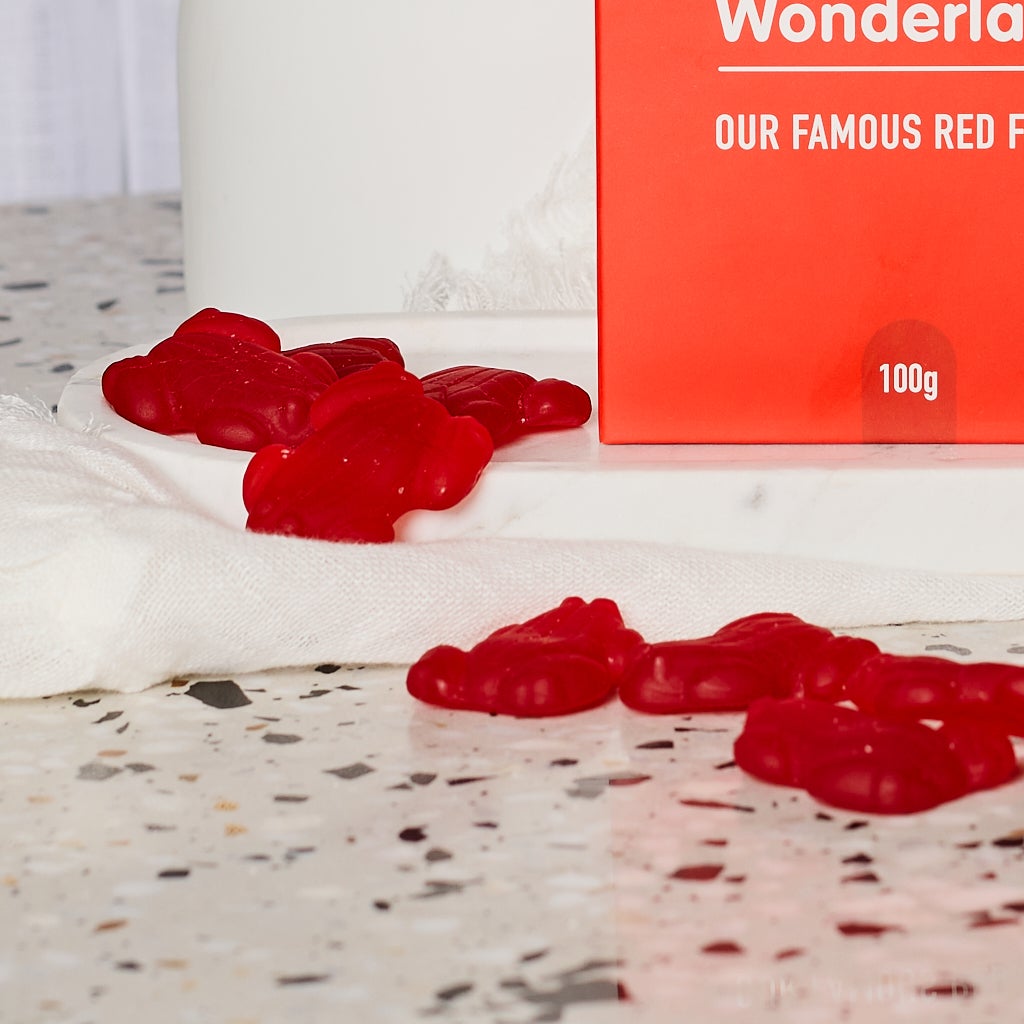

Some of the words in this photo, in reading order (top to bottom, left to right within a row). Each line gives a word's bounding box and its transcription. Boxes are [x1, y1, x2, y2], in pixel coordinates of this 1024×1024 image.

[715, 113, 780, 151] OUR
[792, 113, 922, 150] FAMOUS
[934, 113, 995, 150] RED
[879, 362, 938, 401] 100g
